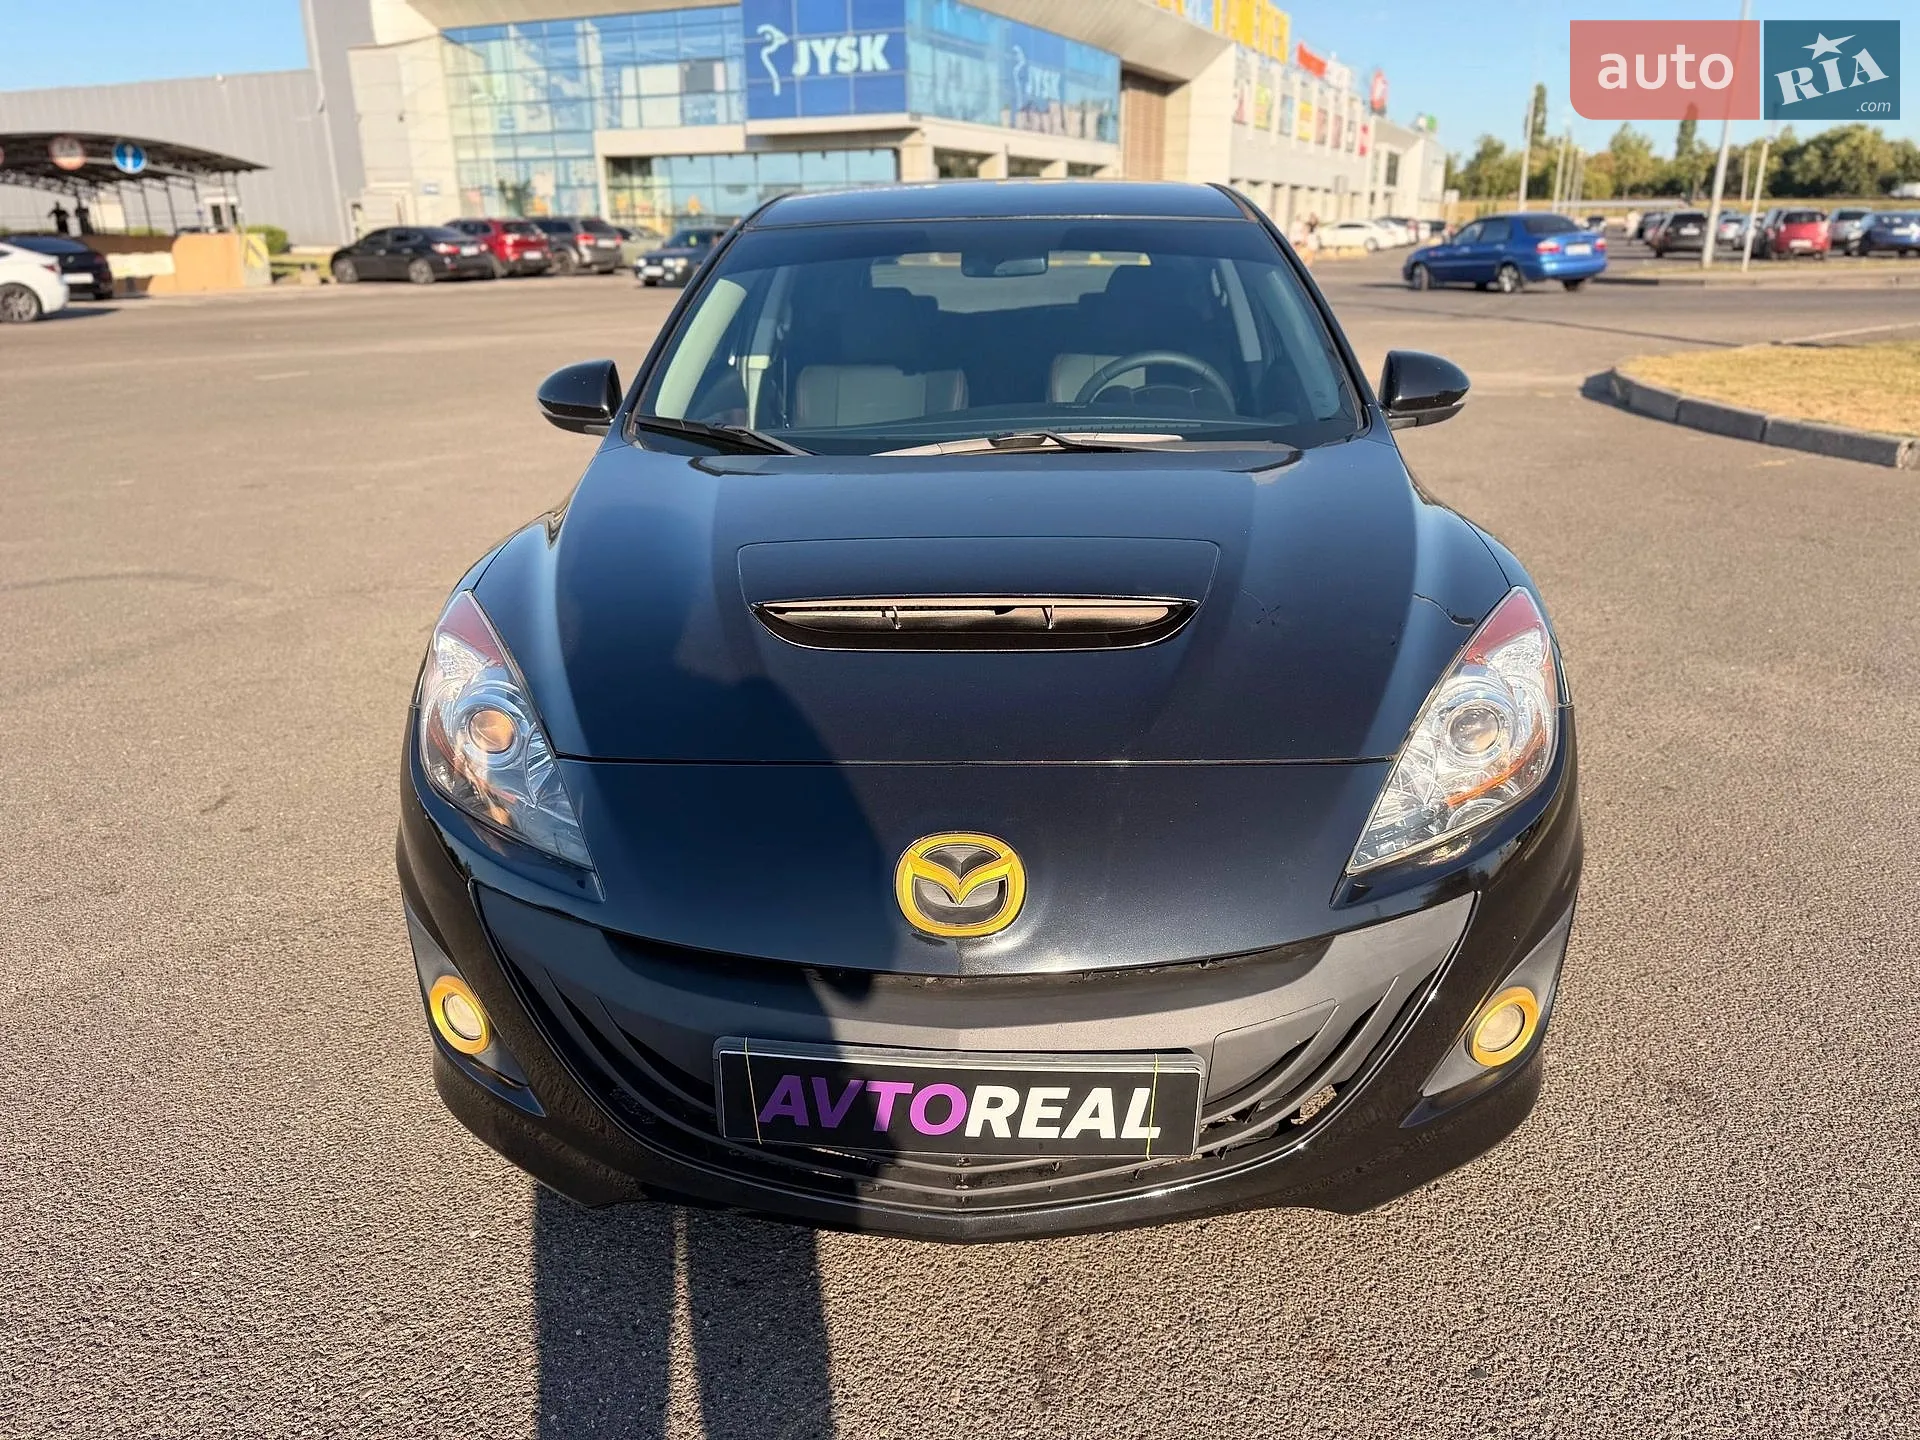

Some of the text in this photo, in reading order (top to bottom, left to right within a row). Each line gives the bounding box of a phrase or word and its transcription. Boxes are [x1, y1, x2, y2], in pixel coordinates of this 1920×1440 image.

[792, 33, 890, 77] JYSK
[1025, 65, 1061, 100] JYSK
[758, 1074, 1161, 1140] AVTOREAL
